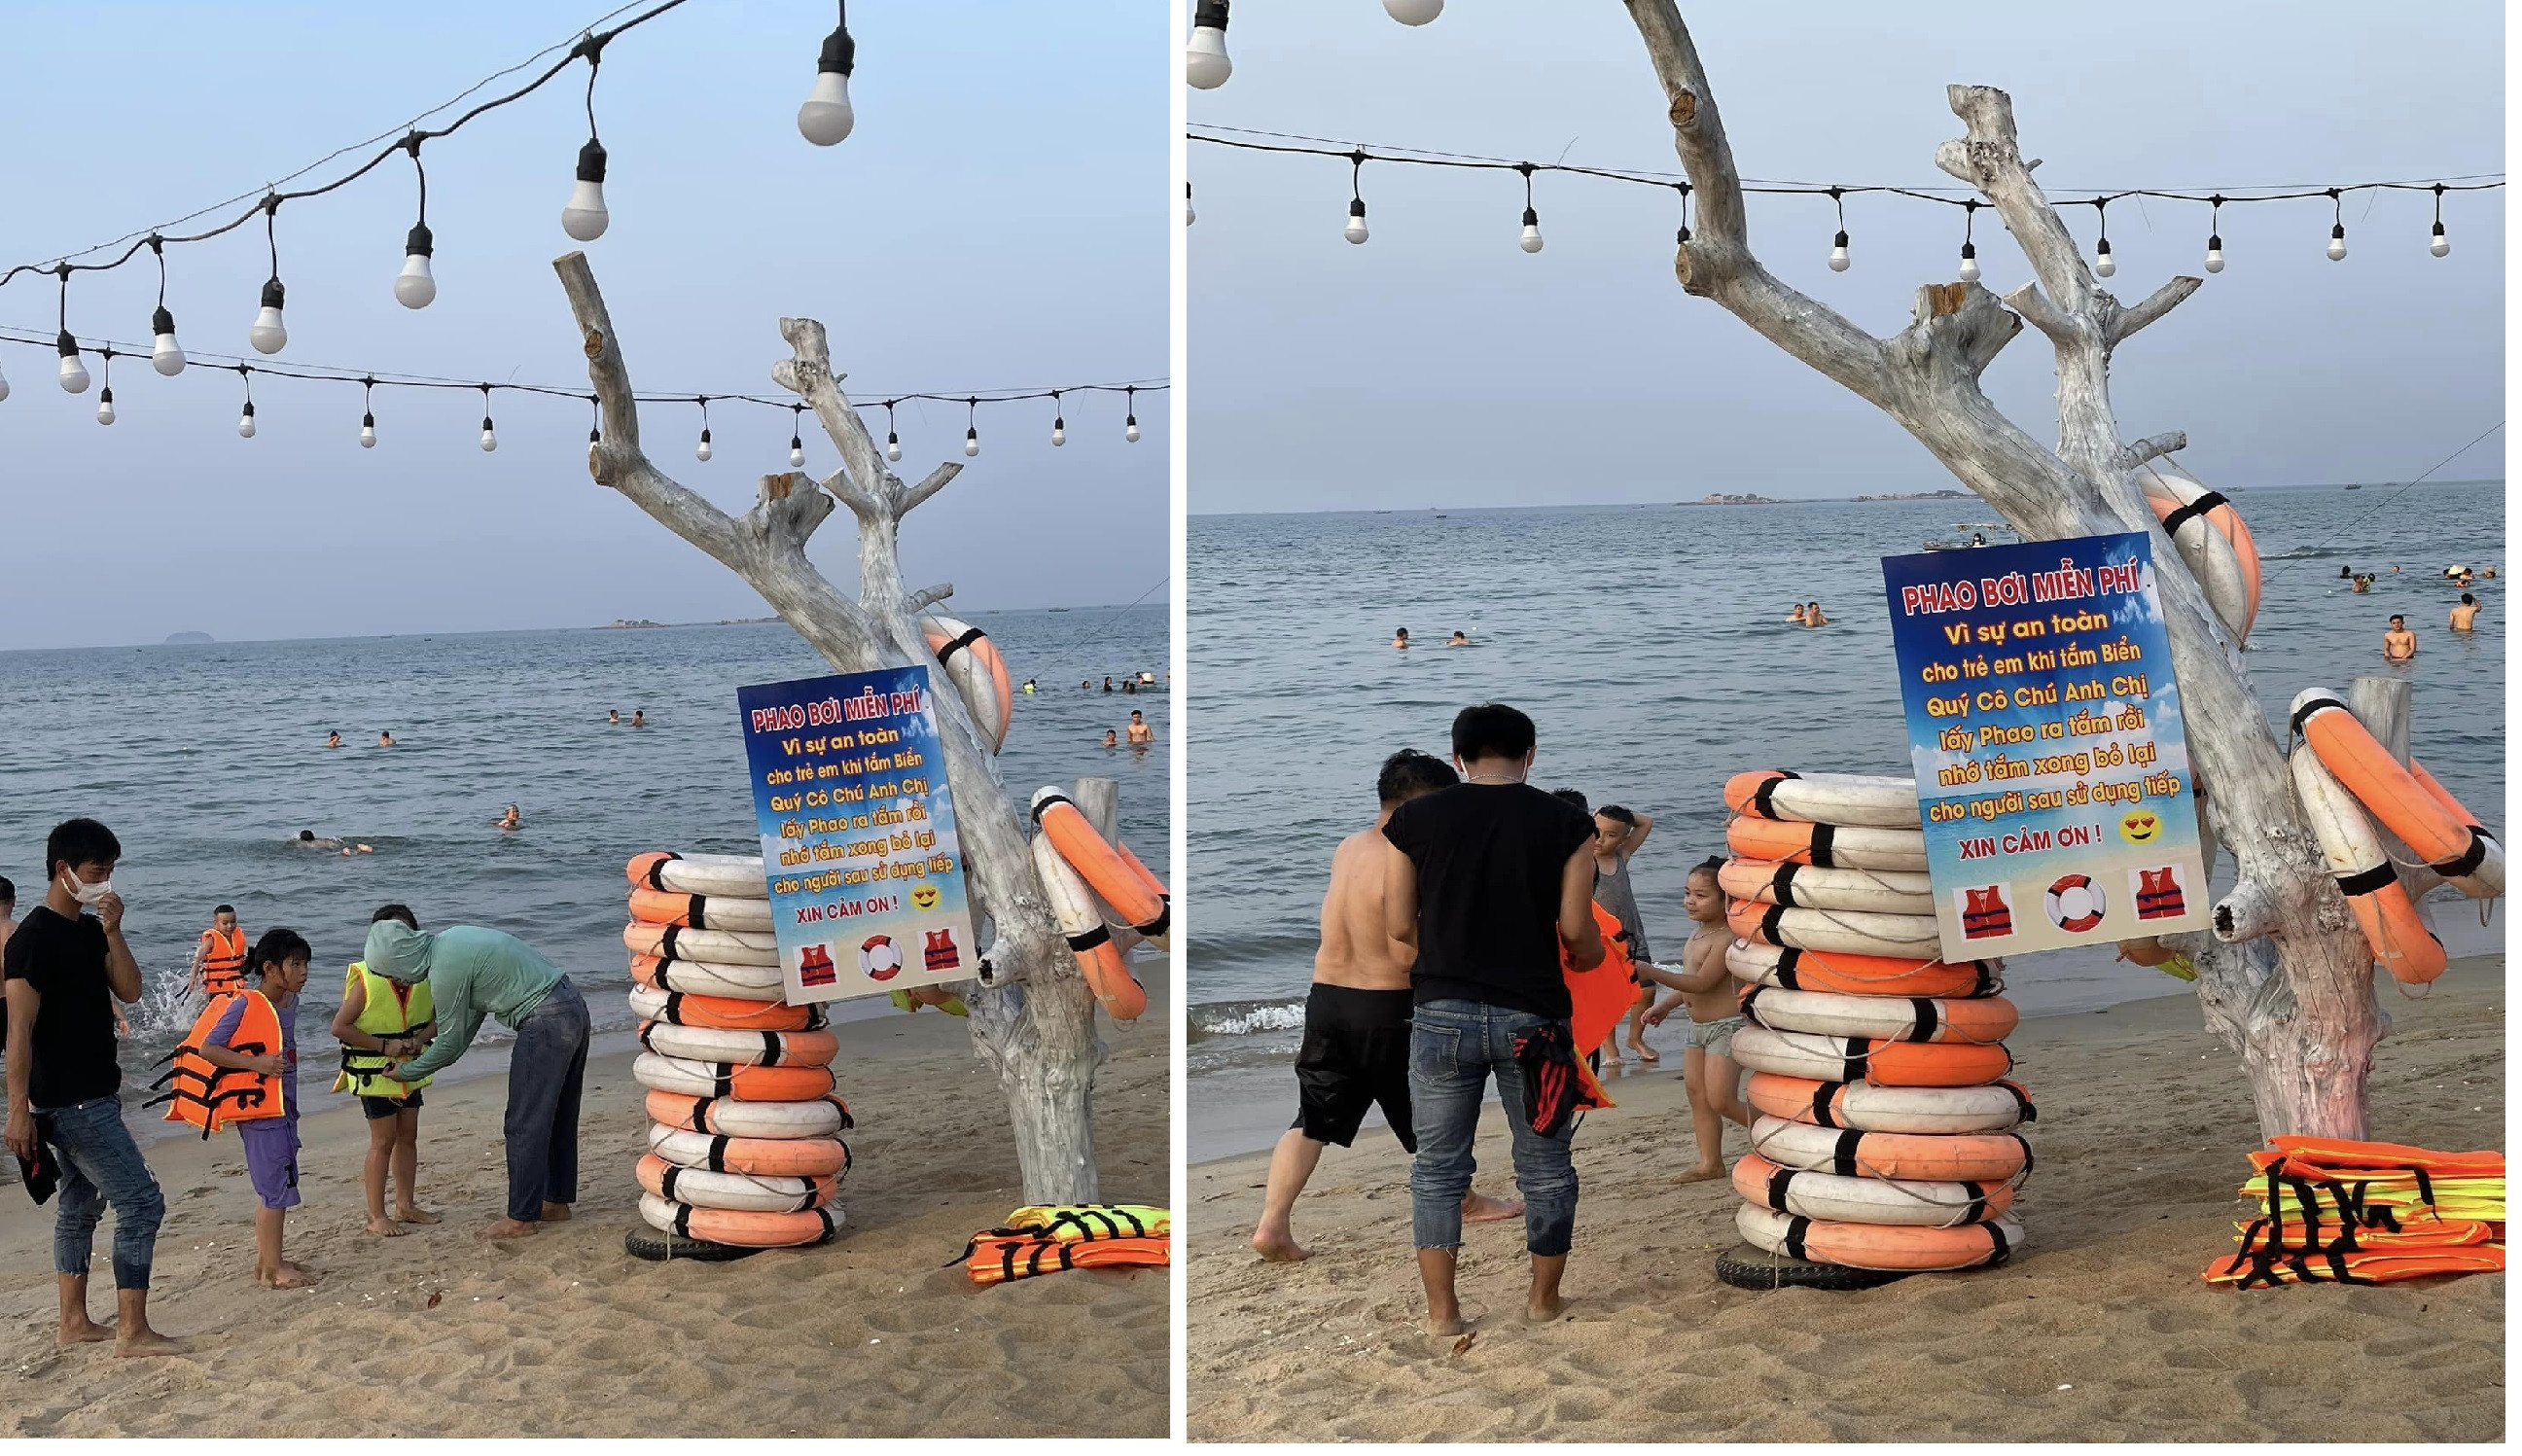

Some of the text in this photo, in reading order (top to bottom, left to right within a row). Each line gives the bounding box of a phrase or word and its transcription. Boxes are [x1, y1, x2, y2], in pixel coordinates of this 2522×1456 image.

[1902, 558, 2140, 616] PHAO BƠI MIỄN PHÍ
[1944, 611, 2109, 646] Vì sự an toàn
[1922, 636, 2142, 684] cho trẻ em khi tắm Biển
[752, 684, 921, 732] PHAO BƠI MIỄN PHÍ
[1926, 674, 2149, 718] Quý Cô Chú Anh Chị
[782, 728, 900, 756] Vì sự an toàn
[1939, 705, 2145, 754] lấy Phao ra tắm rồi
[766, 746, 922, 785] cho trẻ em khi tắm Biển
[1938, 741, 2156, 788] nhớ tắm xong bỏ lại
[770, 778, 928, 812] Quý Cô Chú Anh Chị
[1930, 769, 2181, 823] cho người sau sử dụng tiếp
[780, 801, 926, 839] lấy Phao ra tắm rồi
[780, 832, 936, 867] nhớ tắm xong bỏ lại
[1959, 835, 1996, 860] XIN
[2002, 826, 2051, 853] CẢM
[2056, 824, 2092, 847] ƠN
[774, 853, 953, 894] cho người sau sử dụng tiếp
[797, 906, 822, 924] XIN
[826, 897, 862, 919] CẢM
[867, 896, 890, 914] ƠN
